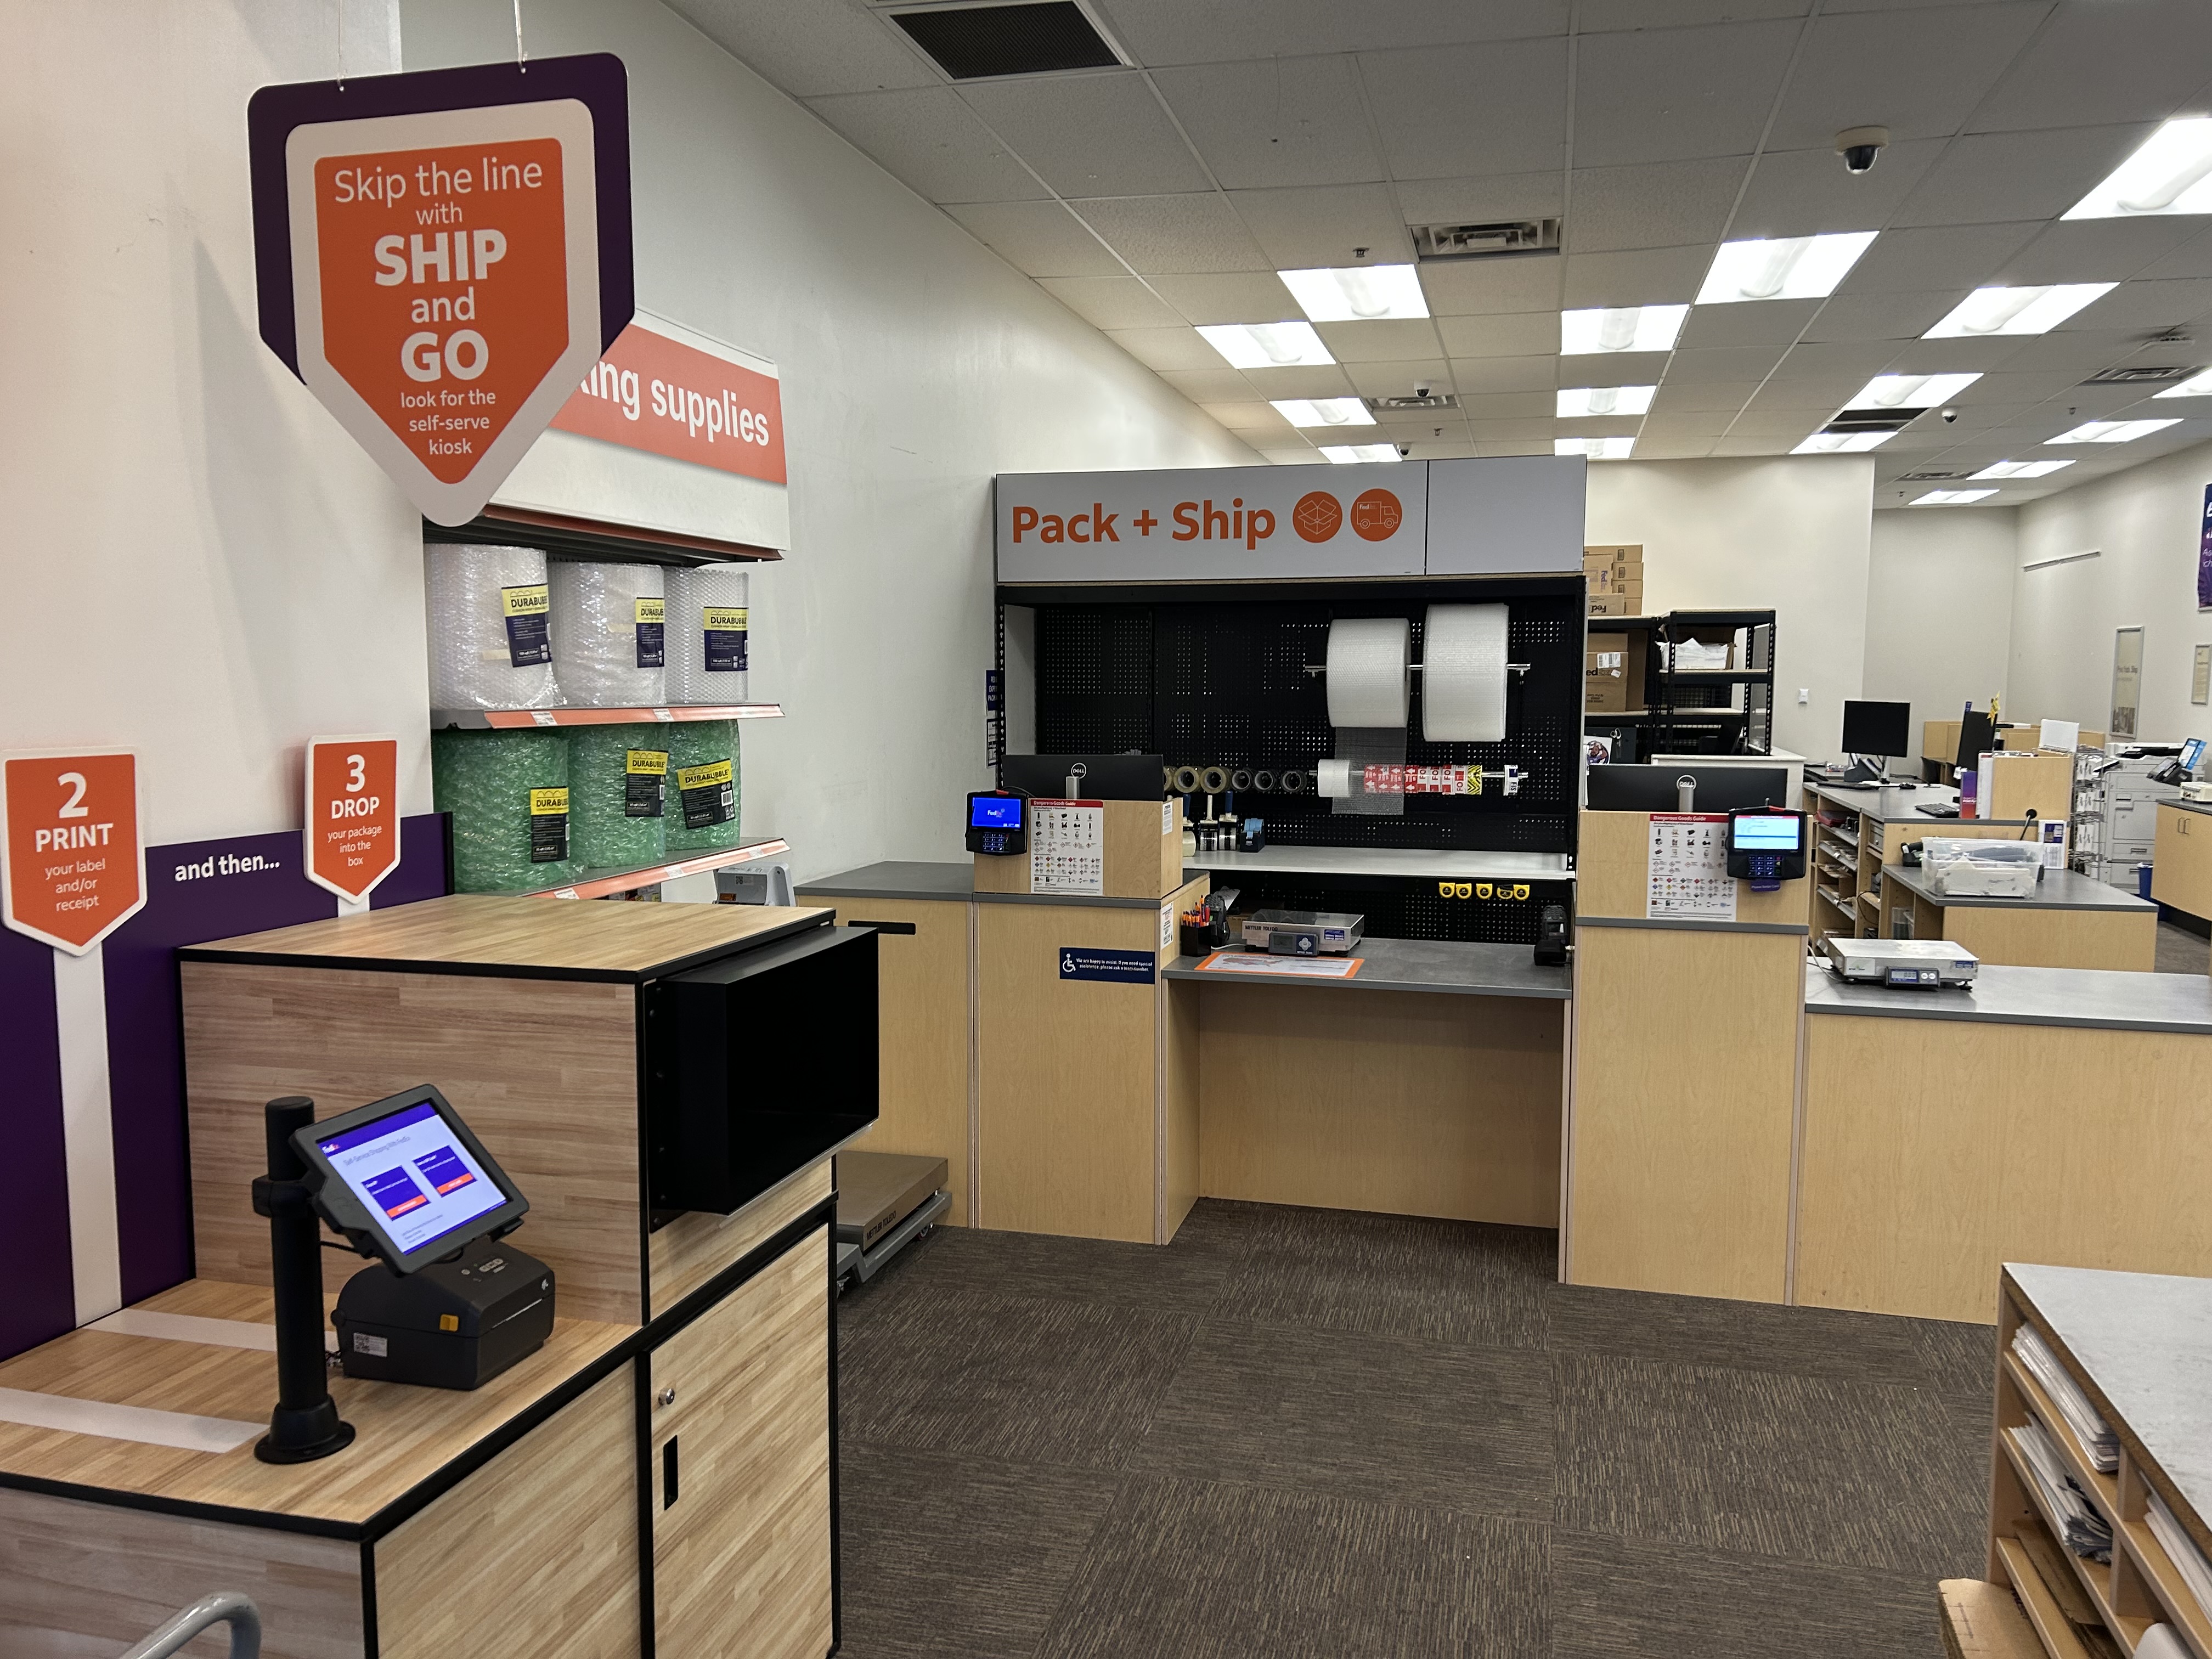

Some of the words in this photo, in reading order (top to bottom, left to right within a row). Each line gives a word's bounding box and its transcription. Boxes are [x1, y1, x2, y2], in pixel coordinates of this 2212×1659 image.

[335, 166, 407, 208] Skip
[415, 161, 472, 196] the
[483, 156, 543, 191] line
[415, 201, 462, 225] with
[375, 229, 507, 287] SHIP
[411, 286, 475, 323] and
[401, 329, 489, 382] GO
[400, 391, 437, 408] look
[440, 390, 465, 406] for
[468, 388, 496, 405] the
[409, 414, 490, 432] self-serve
[651, 379, 769, 447] supplies
[429, 438, 472, 455] kiosk
[1013, 503, 1120, 543] Pack
[1133, 509, 1158, 536] +
[1172, 498, 1276, 550] Ship
[346, 754, 365, 792] 3
[685, 769, 730, 783] DURABUBBLE
[58, 772, 88, 819] 2
[331, 797, 380, 819] DROP
[35, 823, 114, 853] PRINT
[328, 830, 346, 843] your
[347, 825, 382, 838] package
[340, 843, 356, 853] into
[357, 840, 371, 850] the
[45, 864, 74, 880] your
[76, 858, 106, 873] label
[175, 856, 214, 882] and
[218, 853, 280, 875] then...
[348, 856, 364, 867] box
[55, 878, 98, 894] and/or
[56, 895, 99, 912] receipt
[867, 1221, 882, 1240] METTLER
[883, 1210, 896, 1227] TOLEDO
